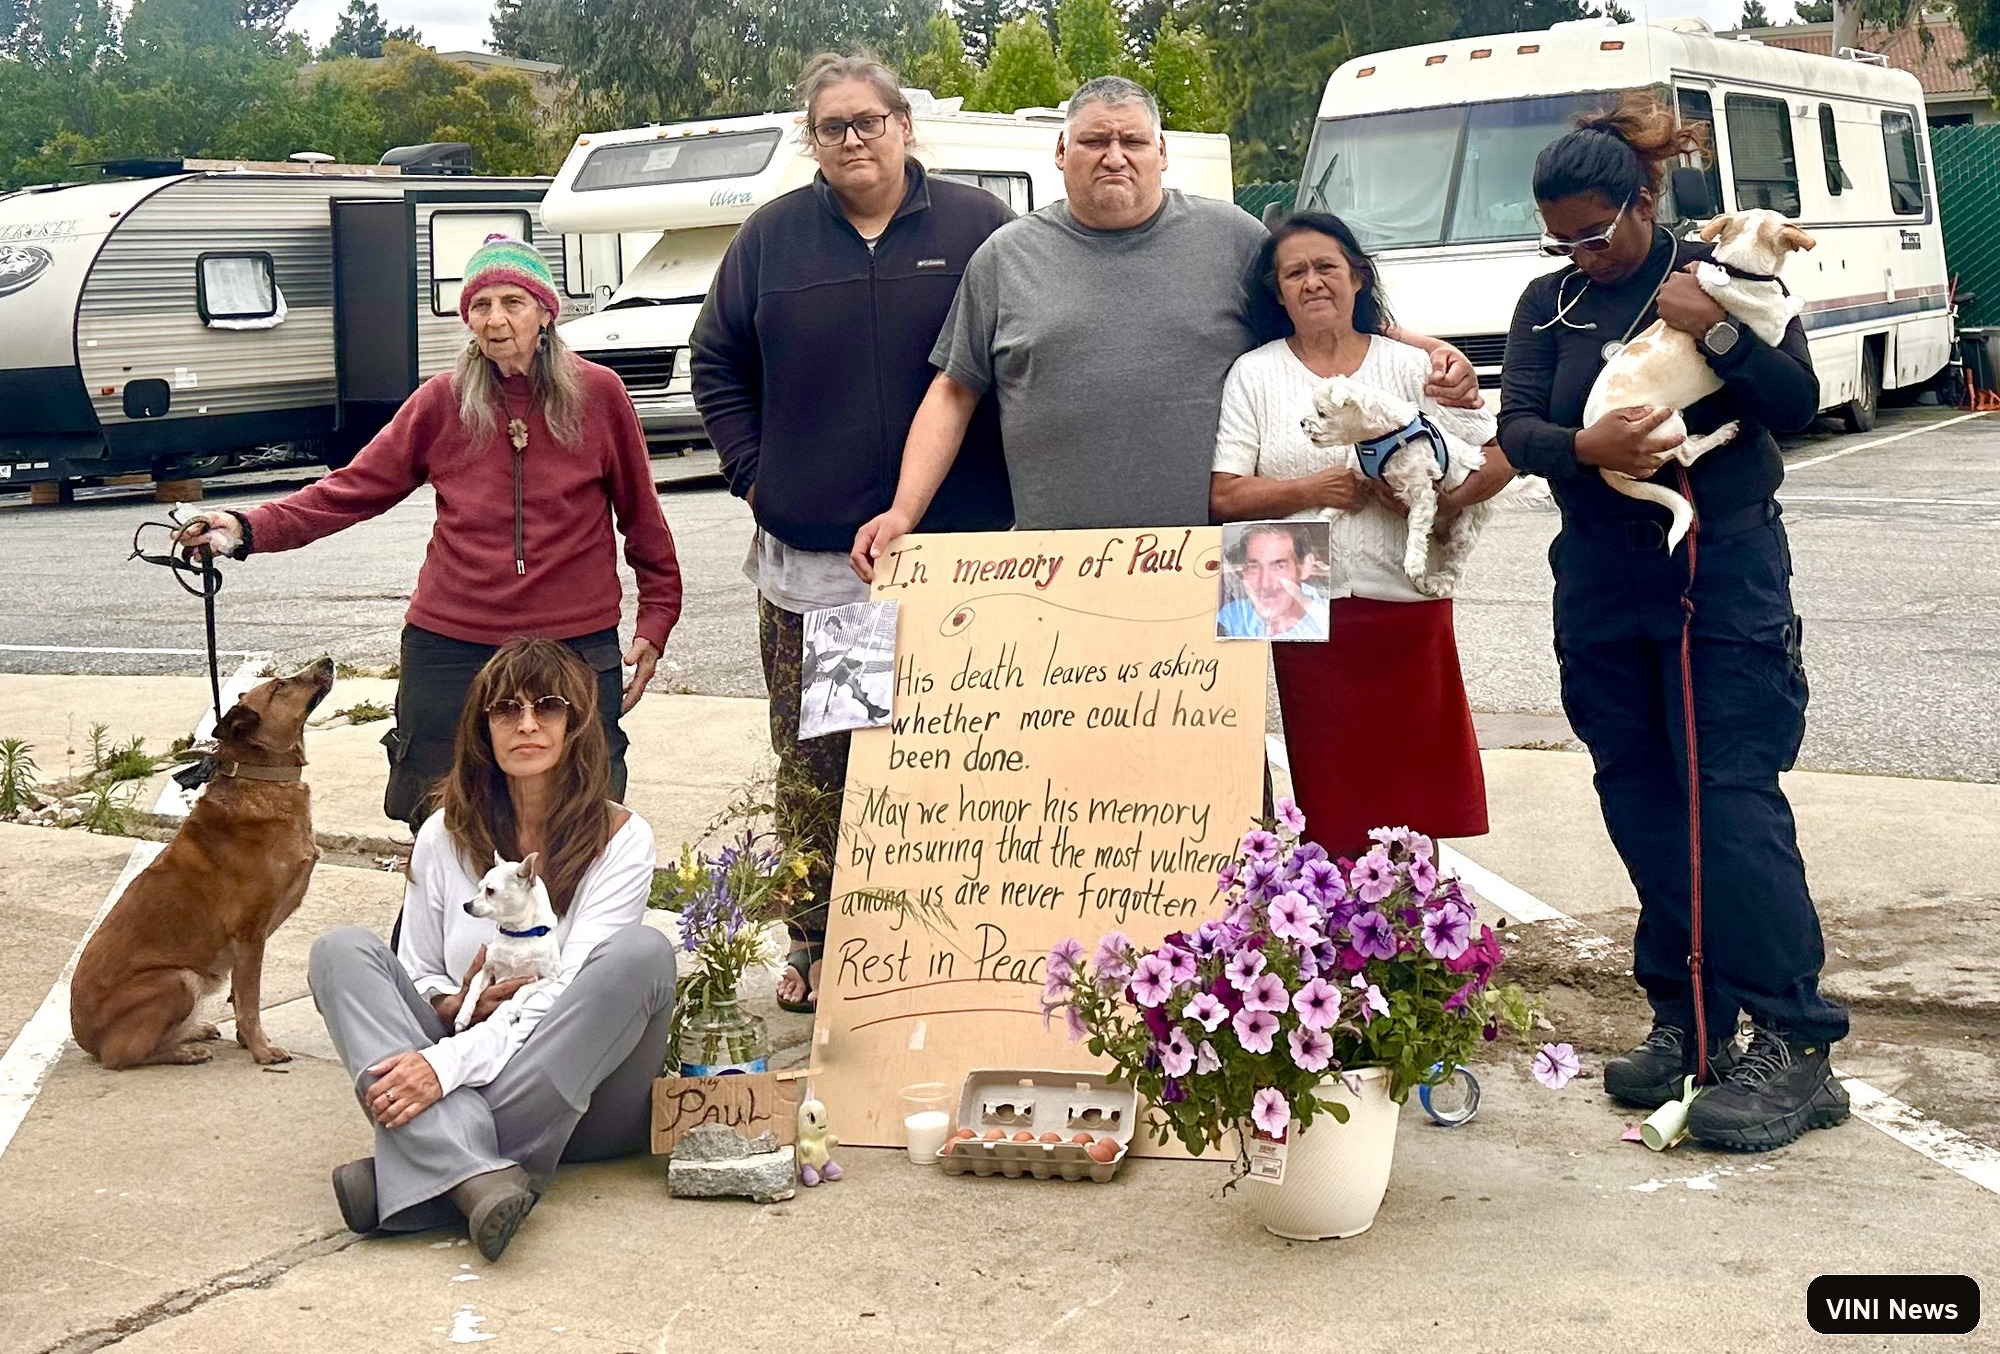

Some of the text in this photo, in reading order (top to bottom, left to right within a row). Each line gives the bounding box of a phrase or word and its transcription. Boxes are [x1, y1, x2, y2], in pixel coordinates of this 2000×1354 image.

[878, 529, 1192, 591] In memory of Paul
[896, 630, 1219, 696] His death leaves us asking
[891, 688, 1237, 736] whether more could have
[889, 733, 1030, 772] been done.
[859, 778, 1211, 844] May we honor his memory
[852, 833, 876, 882] by
[885, 838, 984, 881] ensuring
[996, 824, 1044, 864] that
[1050, 825, 1085, 869] the
[1094, 830, 1142, 872] most
[841, 888, 907, 931] among
[920, 885, 944, 908] us
[955, 882, 990, 905] are
[1001, 881, 1064, 910] never
[837, 923, 1046, 987] Rest in Peac
[660, 1086, 771, 1132] PAUL
[699, 1077, 720, 1092] Hey
